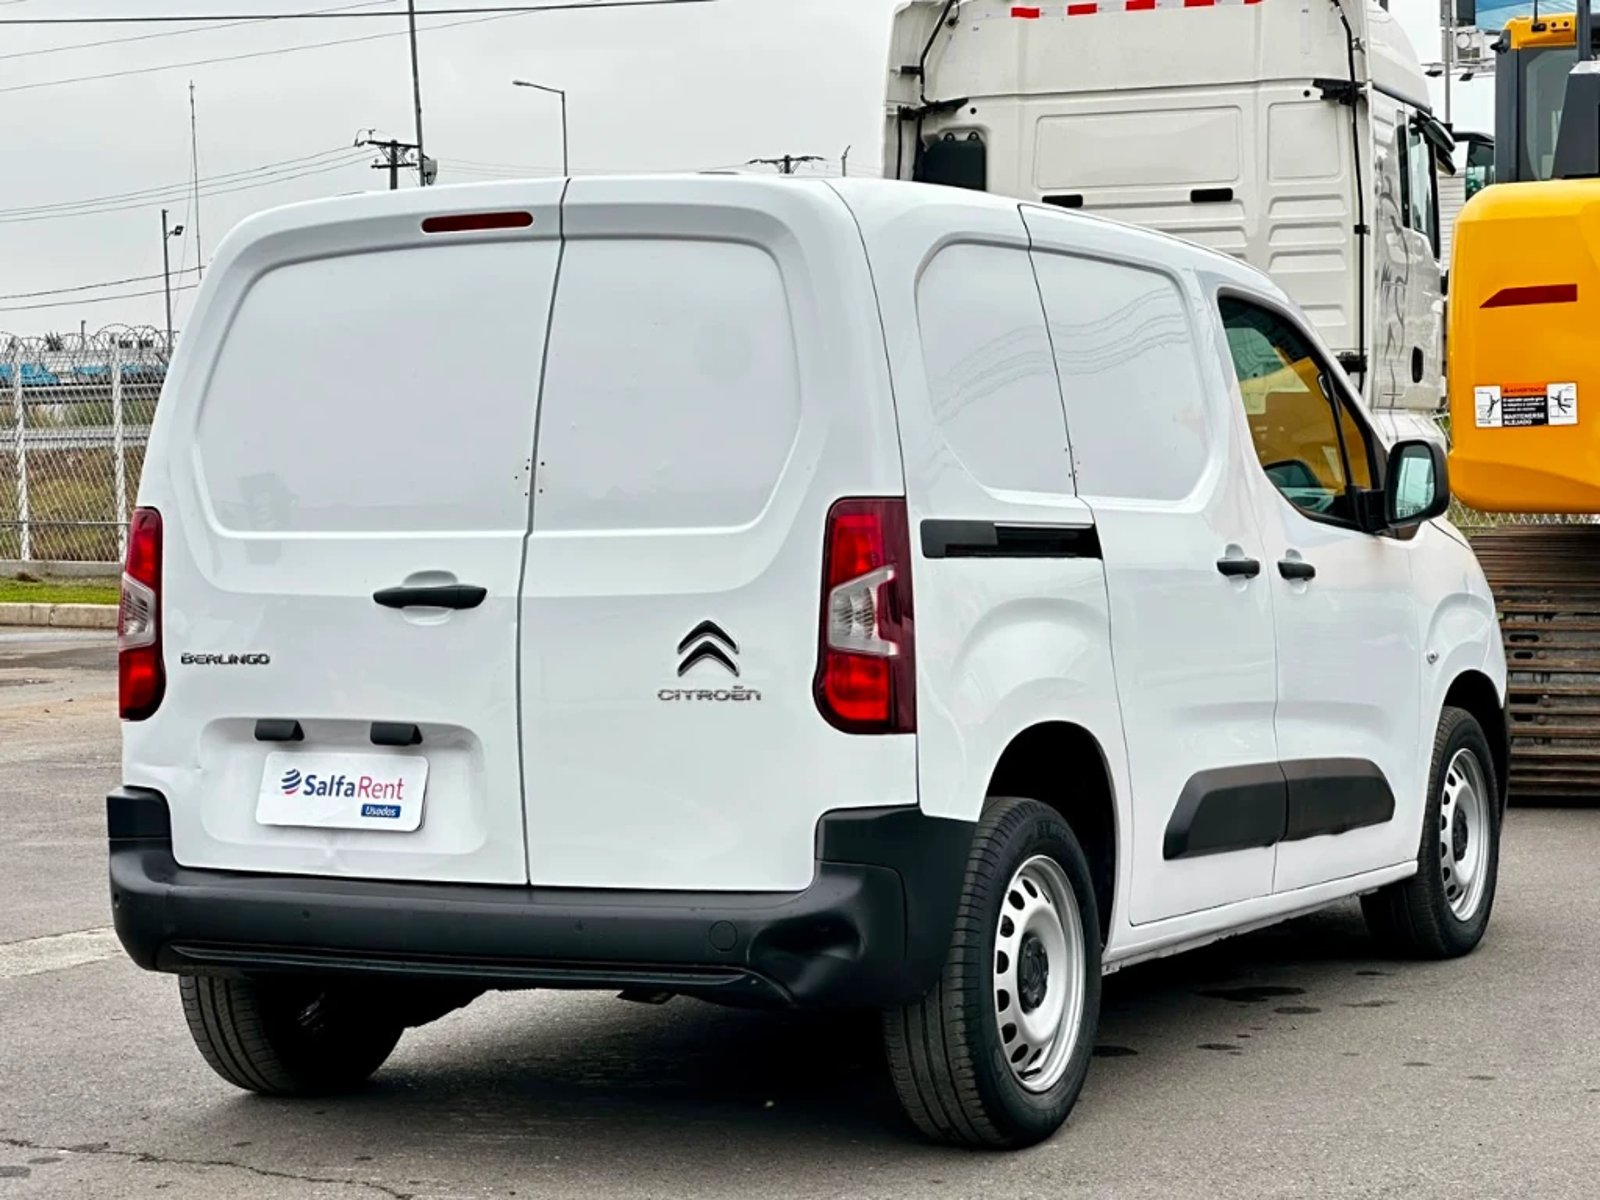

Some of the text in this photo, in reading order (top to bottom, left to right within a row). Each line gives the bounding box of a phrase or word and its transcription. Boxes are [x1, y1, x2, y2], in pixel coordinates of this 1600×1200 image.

[180, 652, 271, 665] BERLINGO
[302, 774, 405, 801] SalfaRent
[365, 805, 397, 817] Usados
